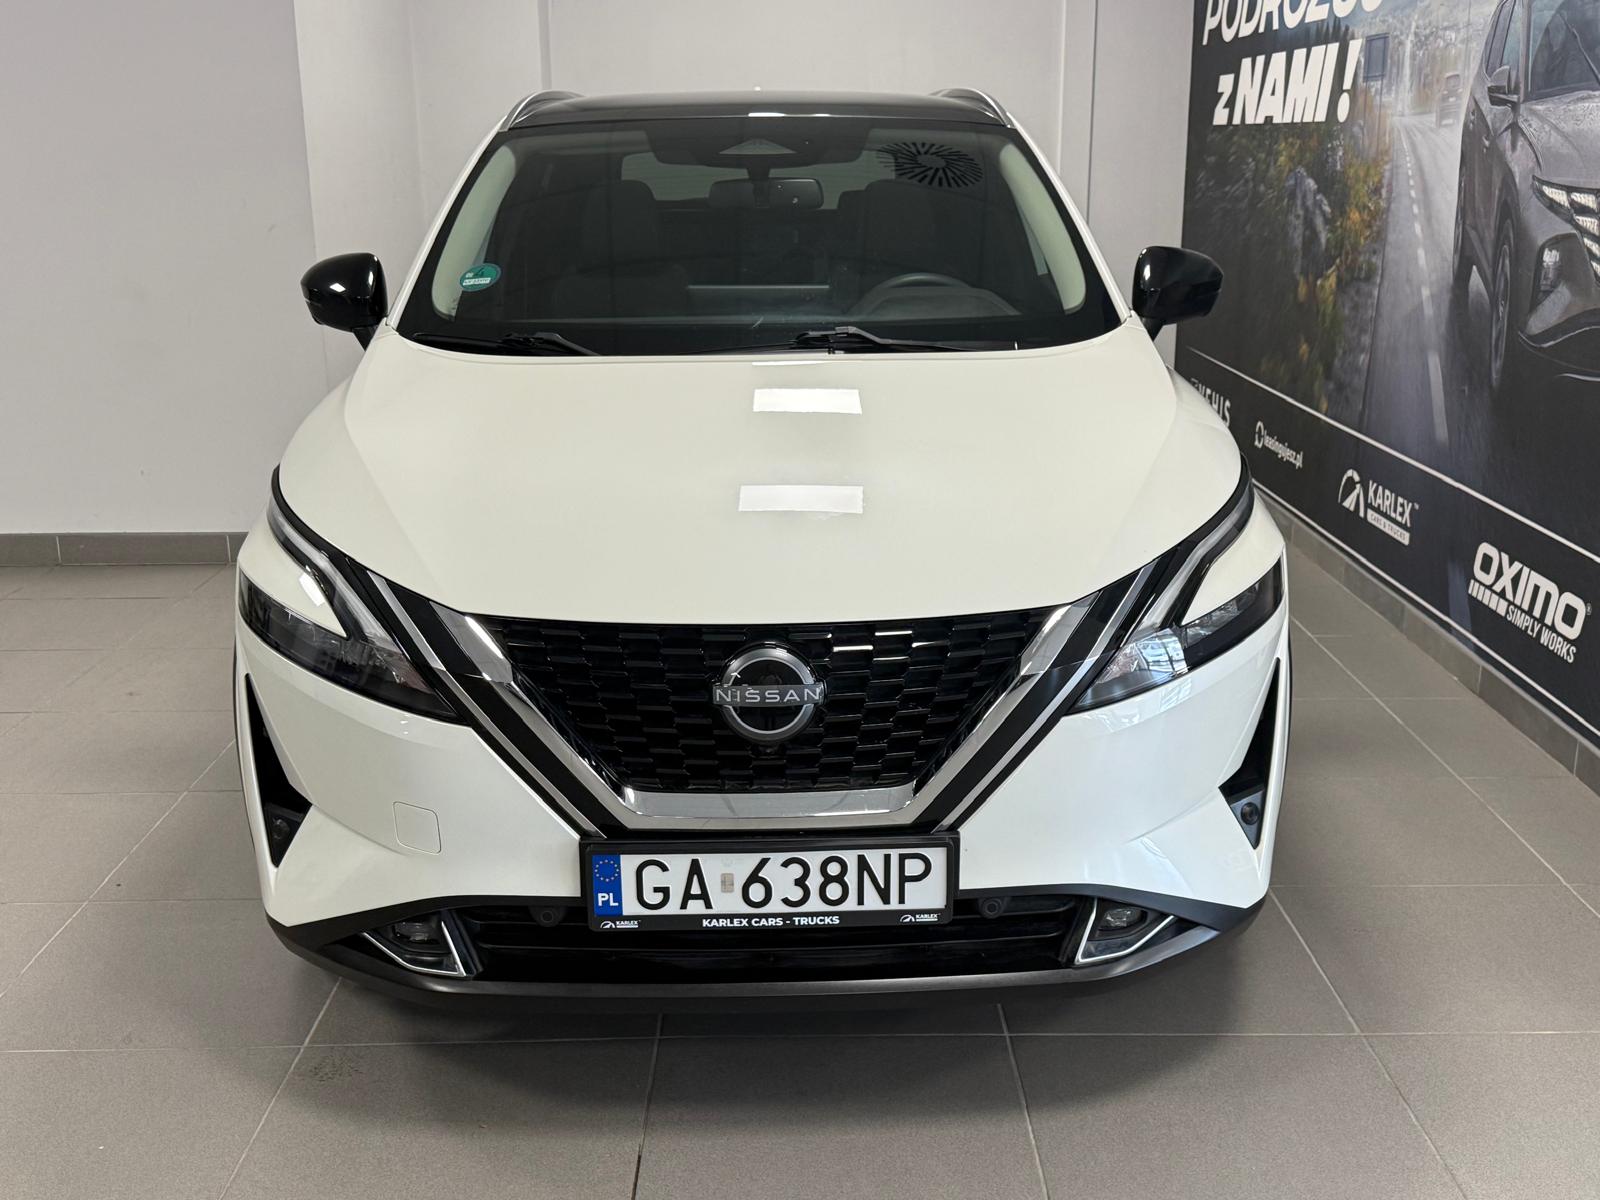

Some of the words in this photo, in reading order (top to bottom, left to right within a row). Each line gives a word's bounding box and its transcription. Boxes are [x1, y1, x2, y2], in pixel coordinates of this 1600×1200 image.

[1202, 0, 1383, 46] PODR
[1473, 541, 1586, 640] OXIMO
[1506, 604, 1541, 639] SIMPLY
[1540, 626, 1577, 663] WORKS
[716, 687, 821, 703] NISSAN
[597, 893, 619, 906] PL
[635, 858, 714, 910] GA
[741, 852, 933, 908] 638NP
[702, 918, 749, 927] KARLEX
[751, 917, 783, 926] CARS
[792, 915, 840, 925] TRUCKS
